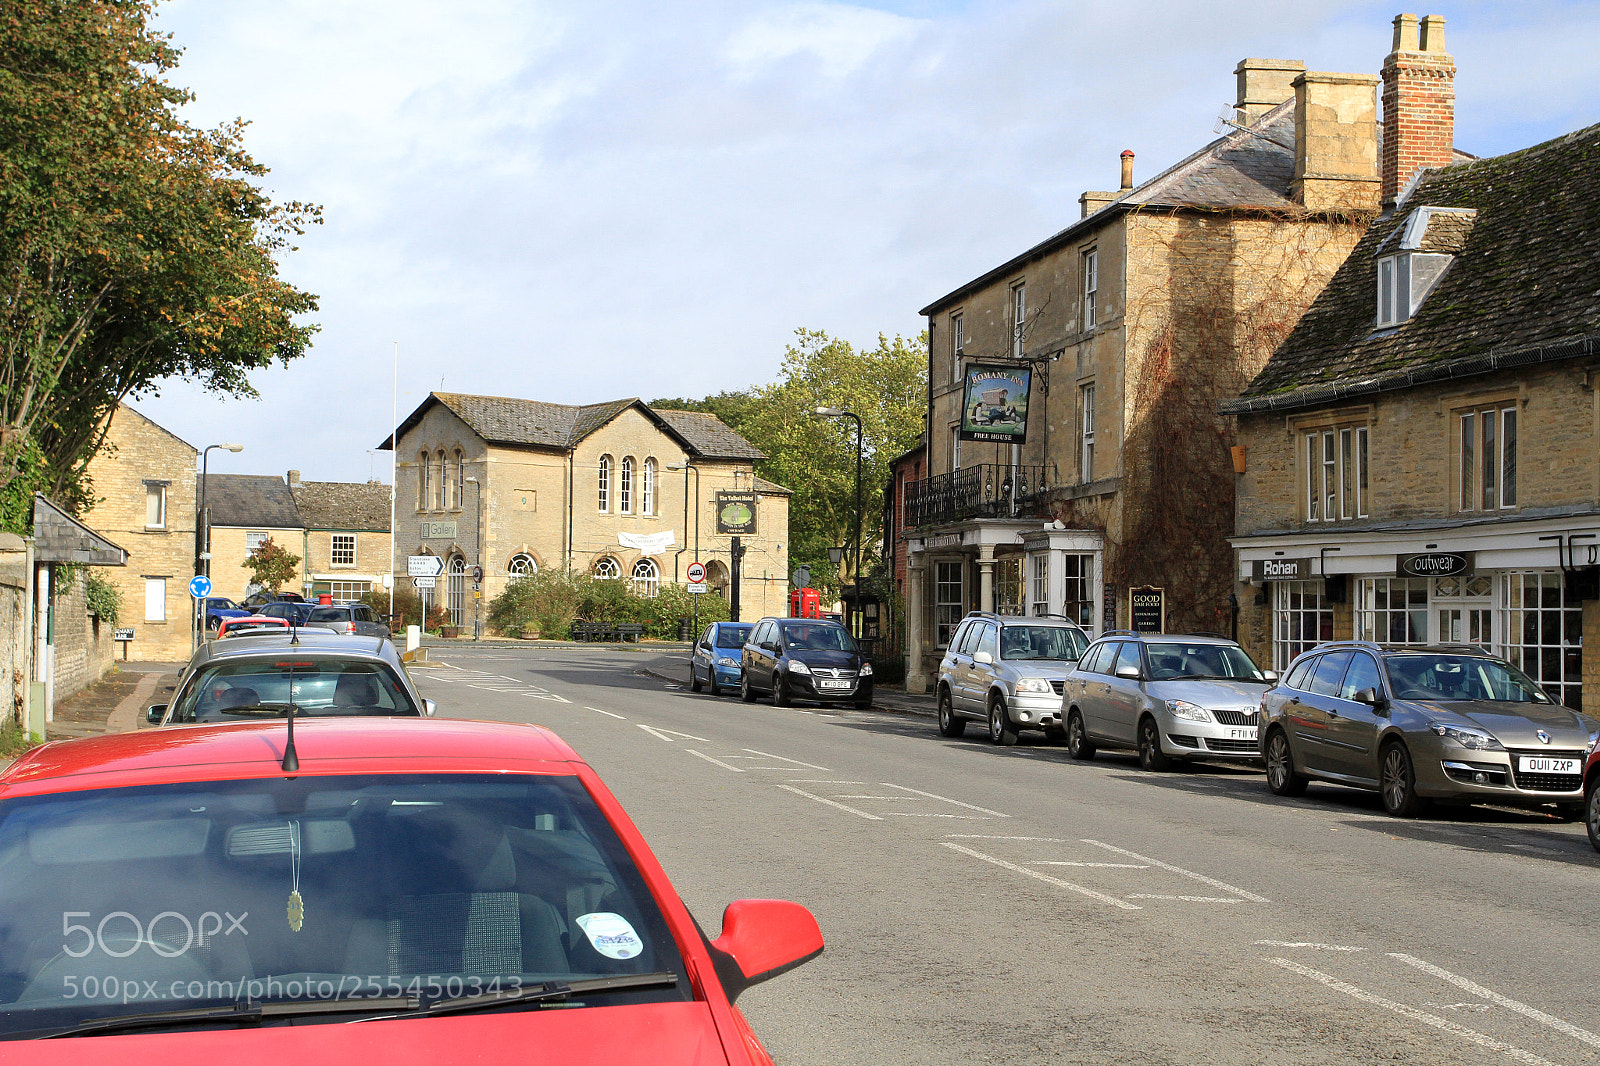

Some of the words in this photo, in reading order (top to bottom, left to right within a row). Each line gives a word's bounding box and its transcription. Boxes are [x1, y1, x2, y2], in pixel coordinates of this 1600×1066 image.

[971, 371, 1009, 384] ROMANY
[1010, 375, 1025, 387] INN
[974, 432, 990, 440] FREE
[991, 433, 1012, 441] HOUSE
[431, 523, 456, 536] Gallery
[1263, 560, 1298, 575] Rohan
[1414, 554, 1454, 571] outwear
[1529, 759, 1550, 771] OU11
[1552, 760, 1573, 772] ZXP
